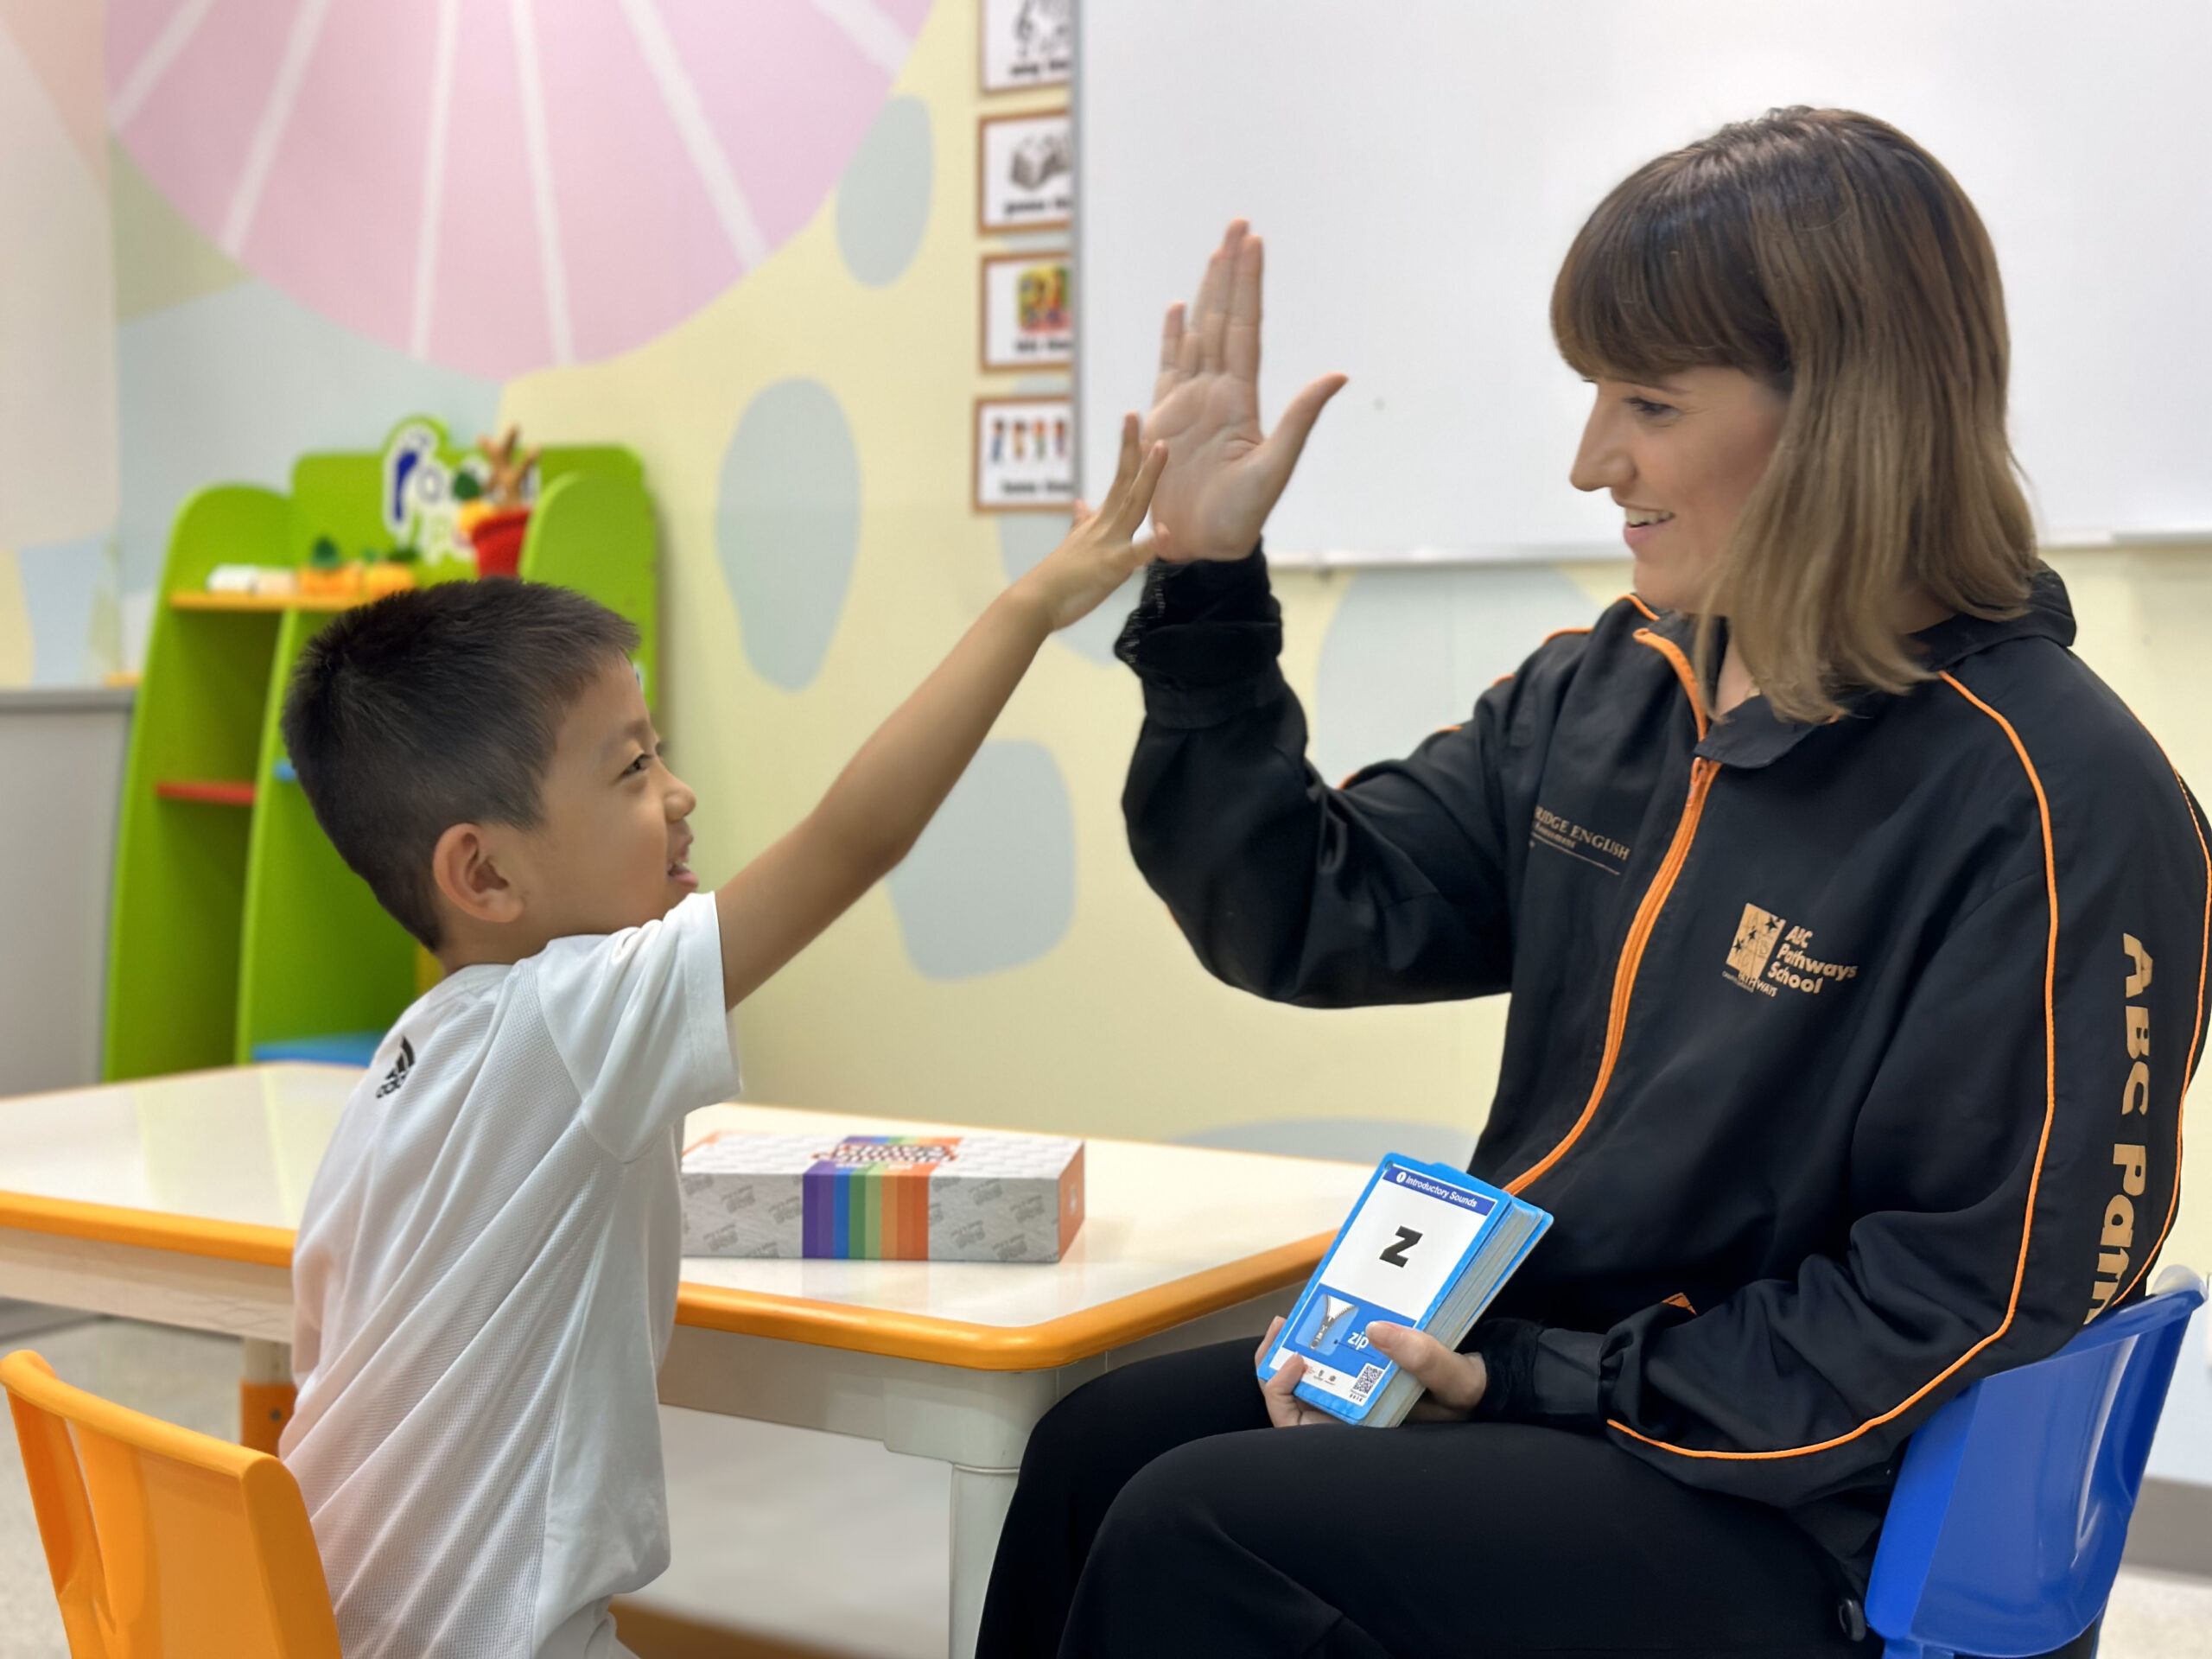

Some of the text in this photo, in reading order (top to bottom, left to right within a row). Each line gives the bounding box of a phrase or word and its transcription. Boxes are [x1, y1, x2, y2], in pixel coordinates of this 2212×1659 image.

[1570, 825, 1630, 861] ENGLISH
[1767, 961, 1824, 994] School
[1777, 943, 1858, 981] Pathways
[2122, 933, 2153, 1116] ABC
[1406, 1175, 1449, 1198] Introductory
[1449, 1191, 1478, 1208] Sounds
[1348, 1331, 1369, 1351] zip
